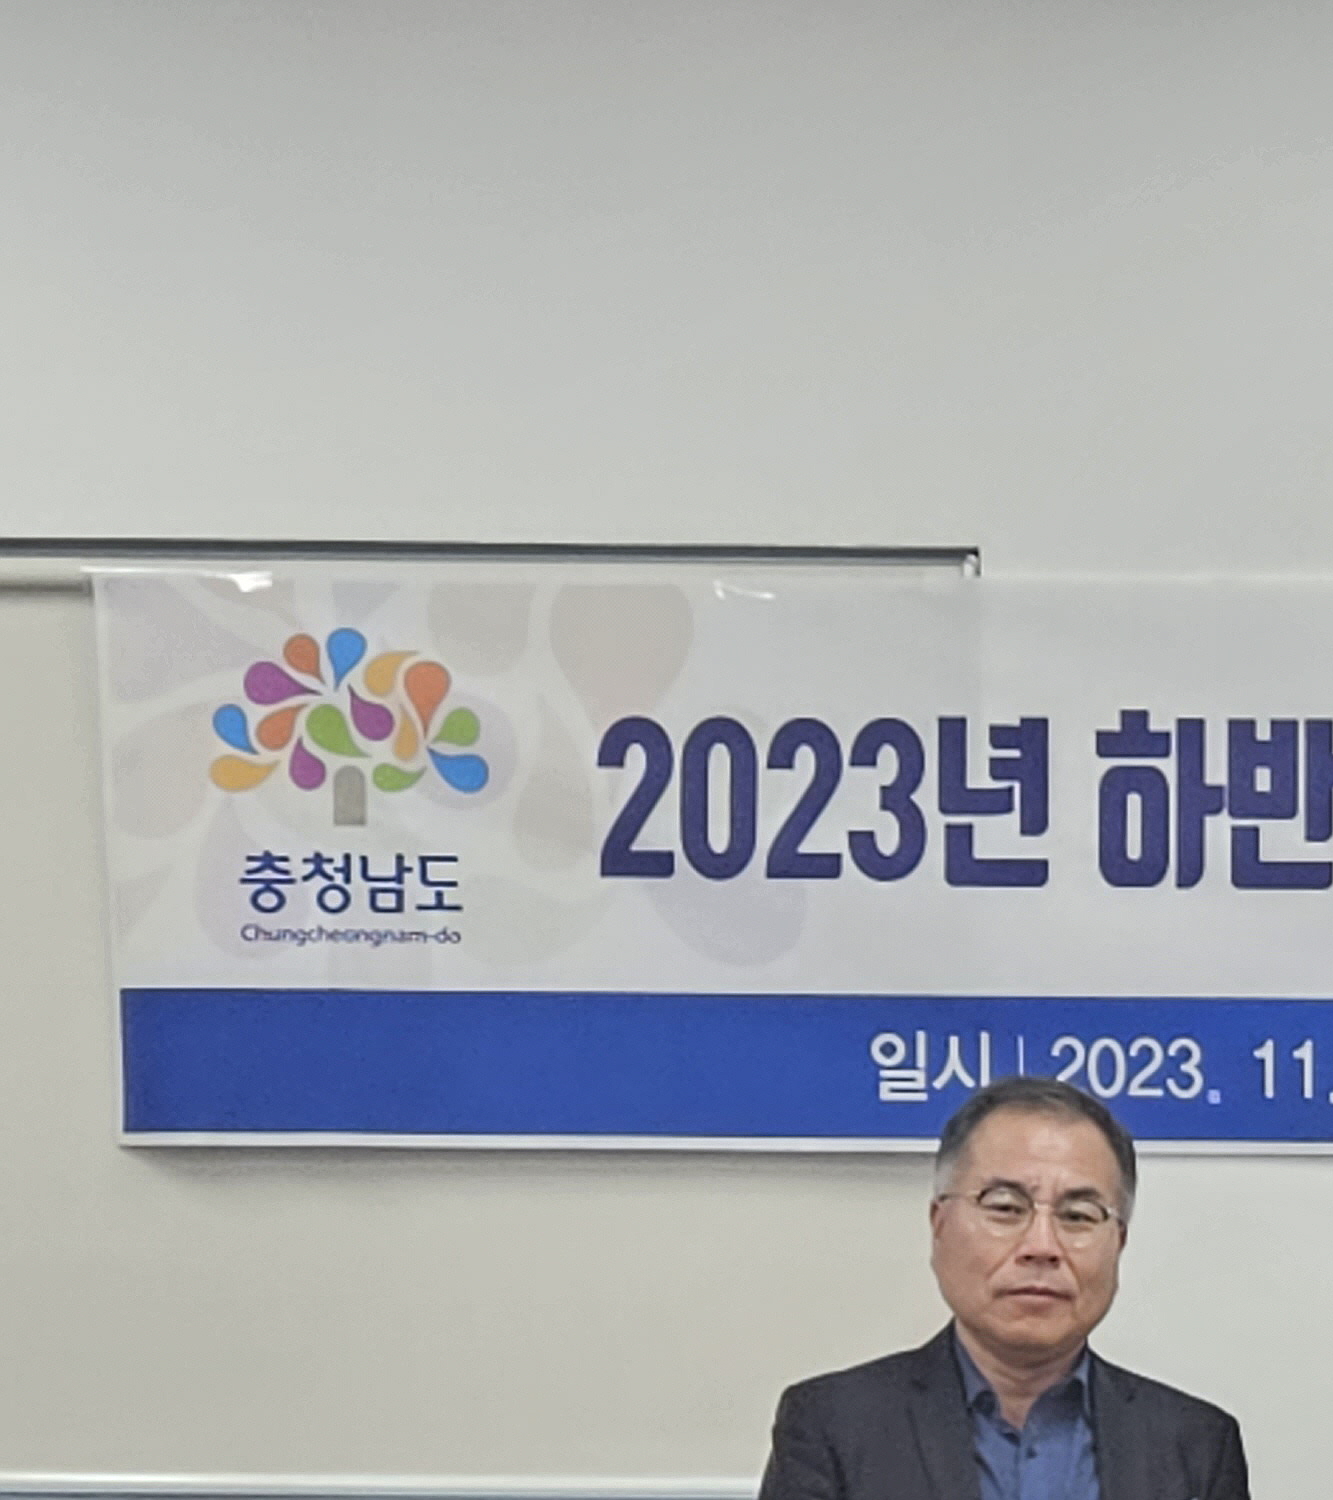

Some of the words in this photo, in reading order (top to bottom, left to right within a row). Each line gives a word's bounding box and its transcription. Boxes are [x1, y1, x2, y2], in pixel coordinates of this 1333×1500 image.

[598, 715, 1050, 888] 2023년
[239, 850, 464, 915] 충청남도
[239, 922, 463, 949] Chungcheongnam-do
[870, 1030, 991, 1102] 일시
[1050, 1036, 1222, 1105] 2023.
